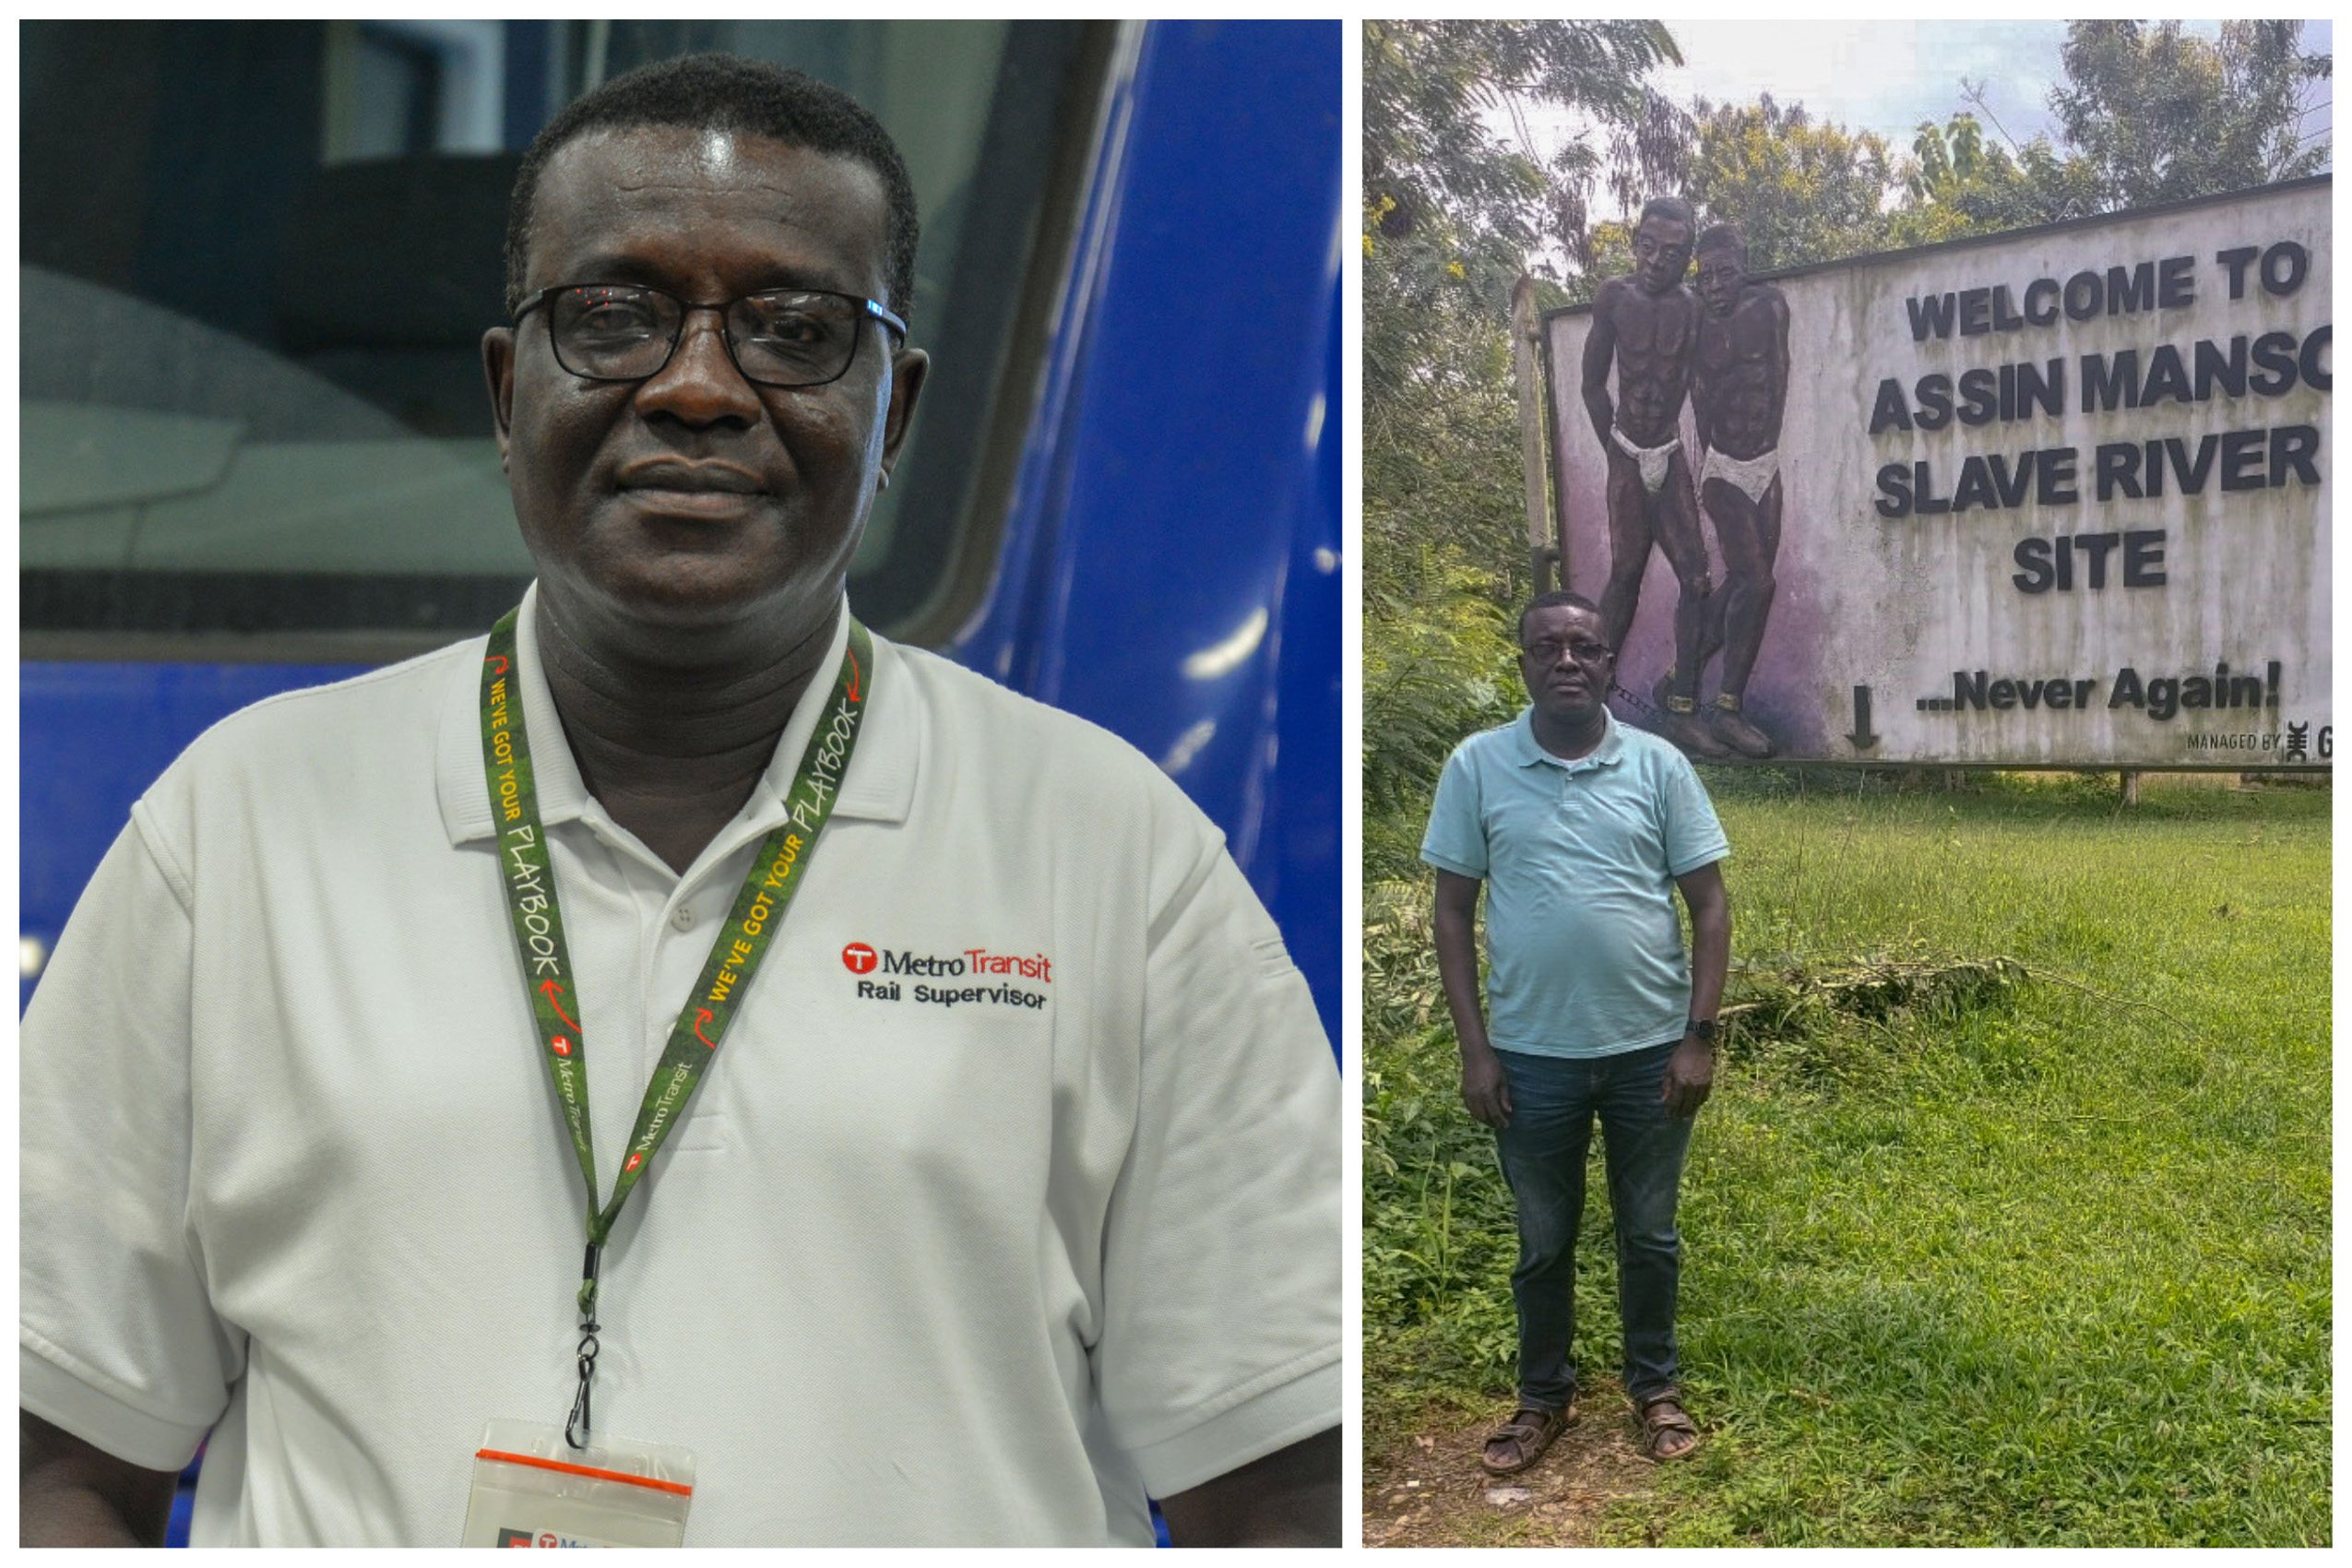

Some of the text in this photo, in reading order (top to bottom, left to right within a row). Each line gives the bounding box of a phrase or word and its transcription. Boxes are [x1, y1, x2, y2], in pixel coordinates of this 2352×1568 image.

[1905, 241, 2308, 341] WELCOME TO
[1869, 357, 2065, 434] ASSIN
[1873, 424, 2321, 518] SLAVE RIVER
[2012, 529, 2168, 595] SITE
[1916, 660, 2282, 721] ...Never Again!
[2187, 733, 2257, 751] MANAGED
[2262, 733, 2282, 751] BY
[491, 679, 560, 976] WE'VE GOT YOUR PLAYBOOK
[708, 697, 858, 1003] WE'VE GOT YOUR PLAYBOOK
[858, 980, 1047, 1010] Rail Supervisor
